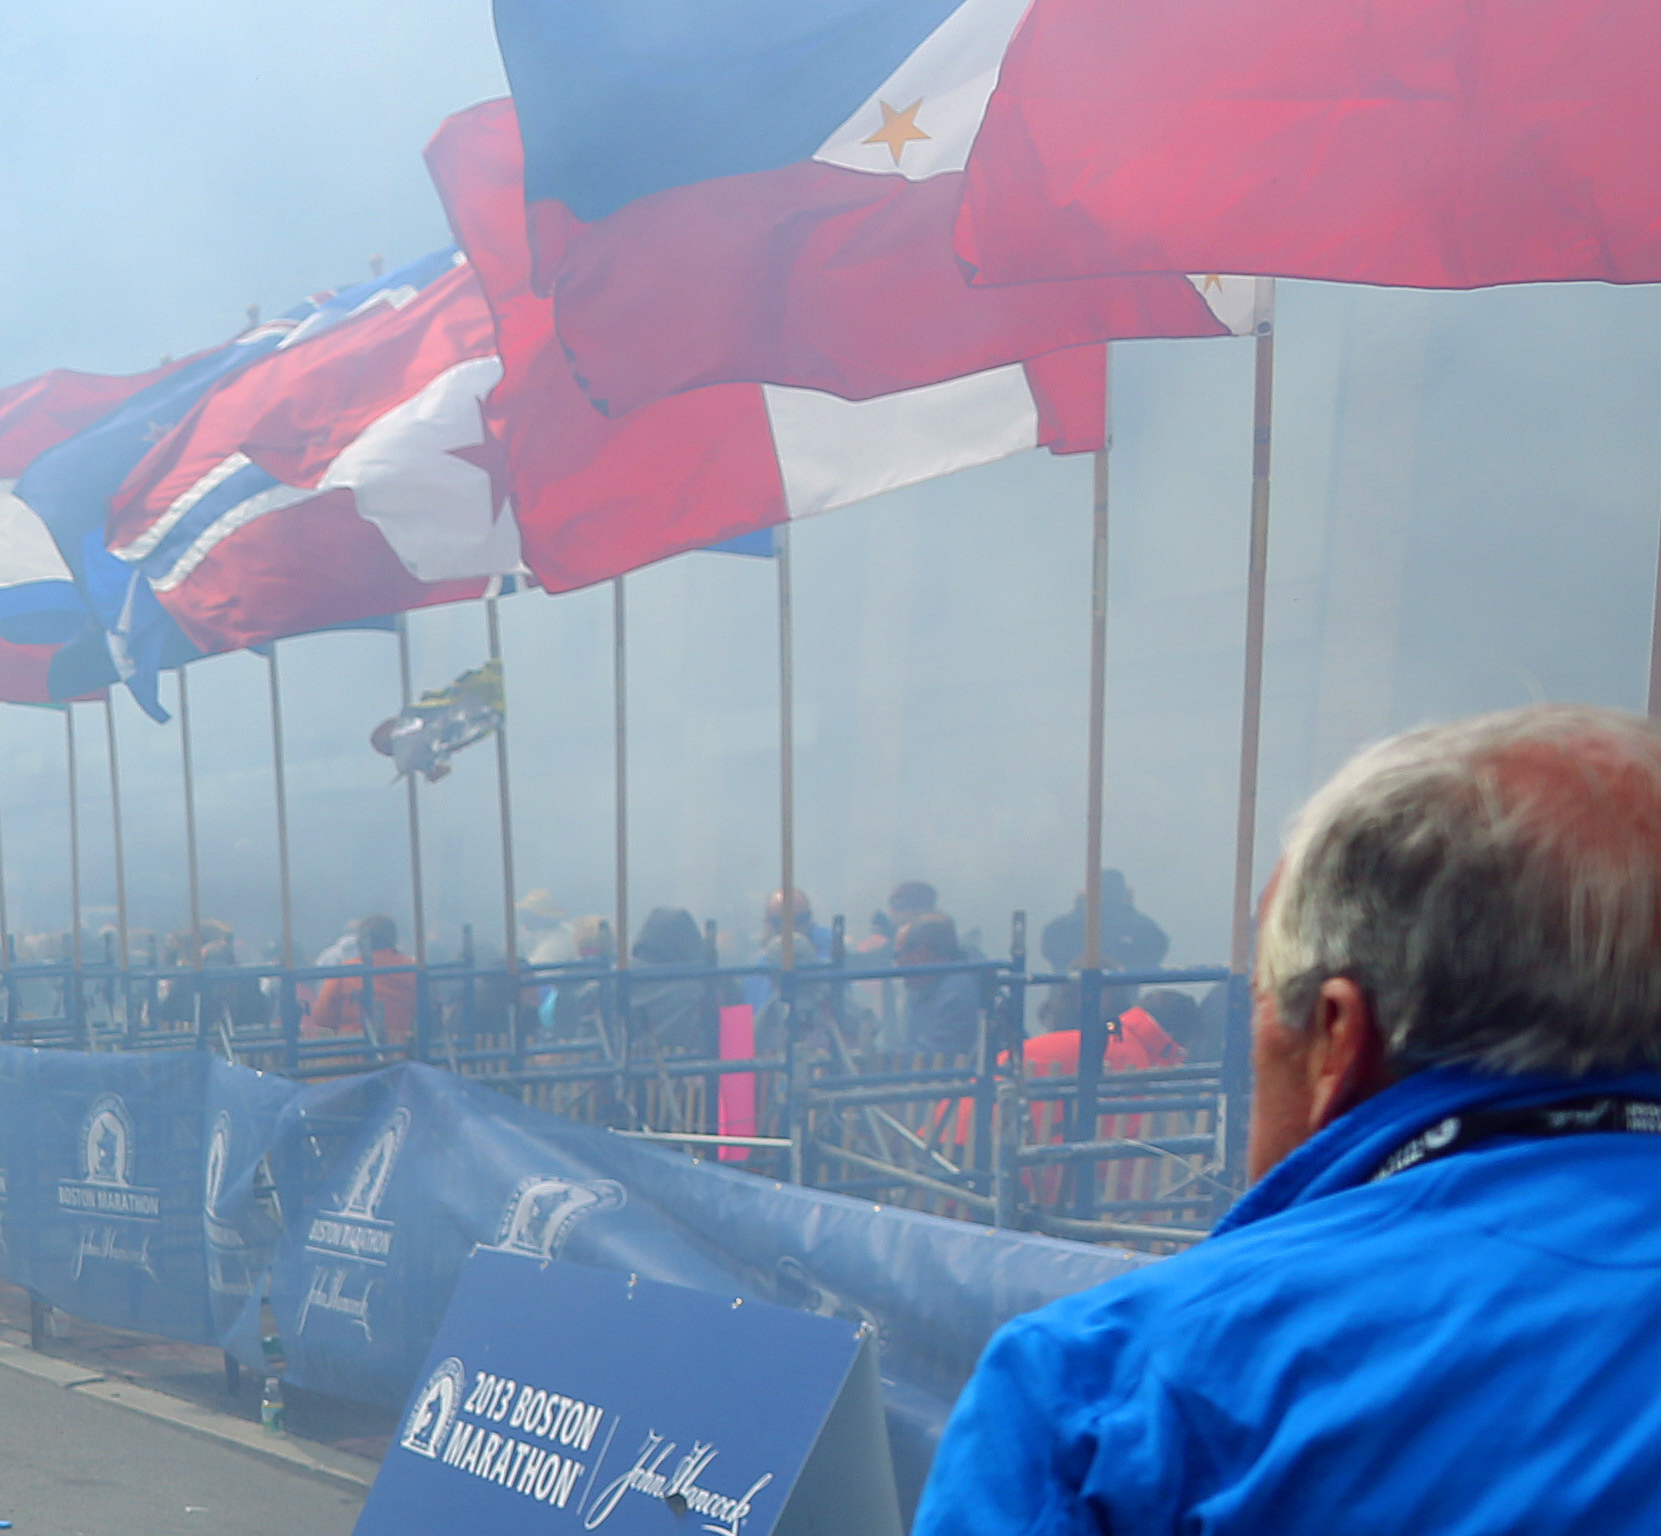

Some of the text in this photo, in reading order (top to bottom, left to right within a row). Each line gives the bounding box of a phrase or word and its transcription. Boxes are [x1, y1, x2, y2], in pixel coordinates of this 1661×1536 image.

[463, 1370, 517, 1422] 2013
[509, 1385, 605, 1452] BOSTON
[442, 1420, 585, 1510] MARATHON
[583, 1427, 678, 1531] John
